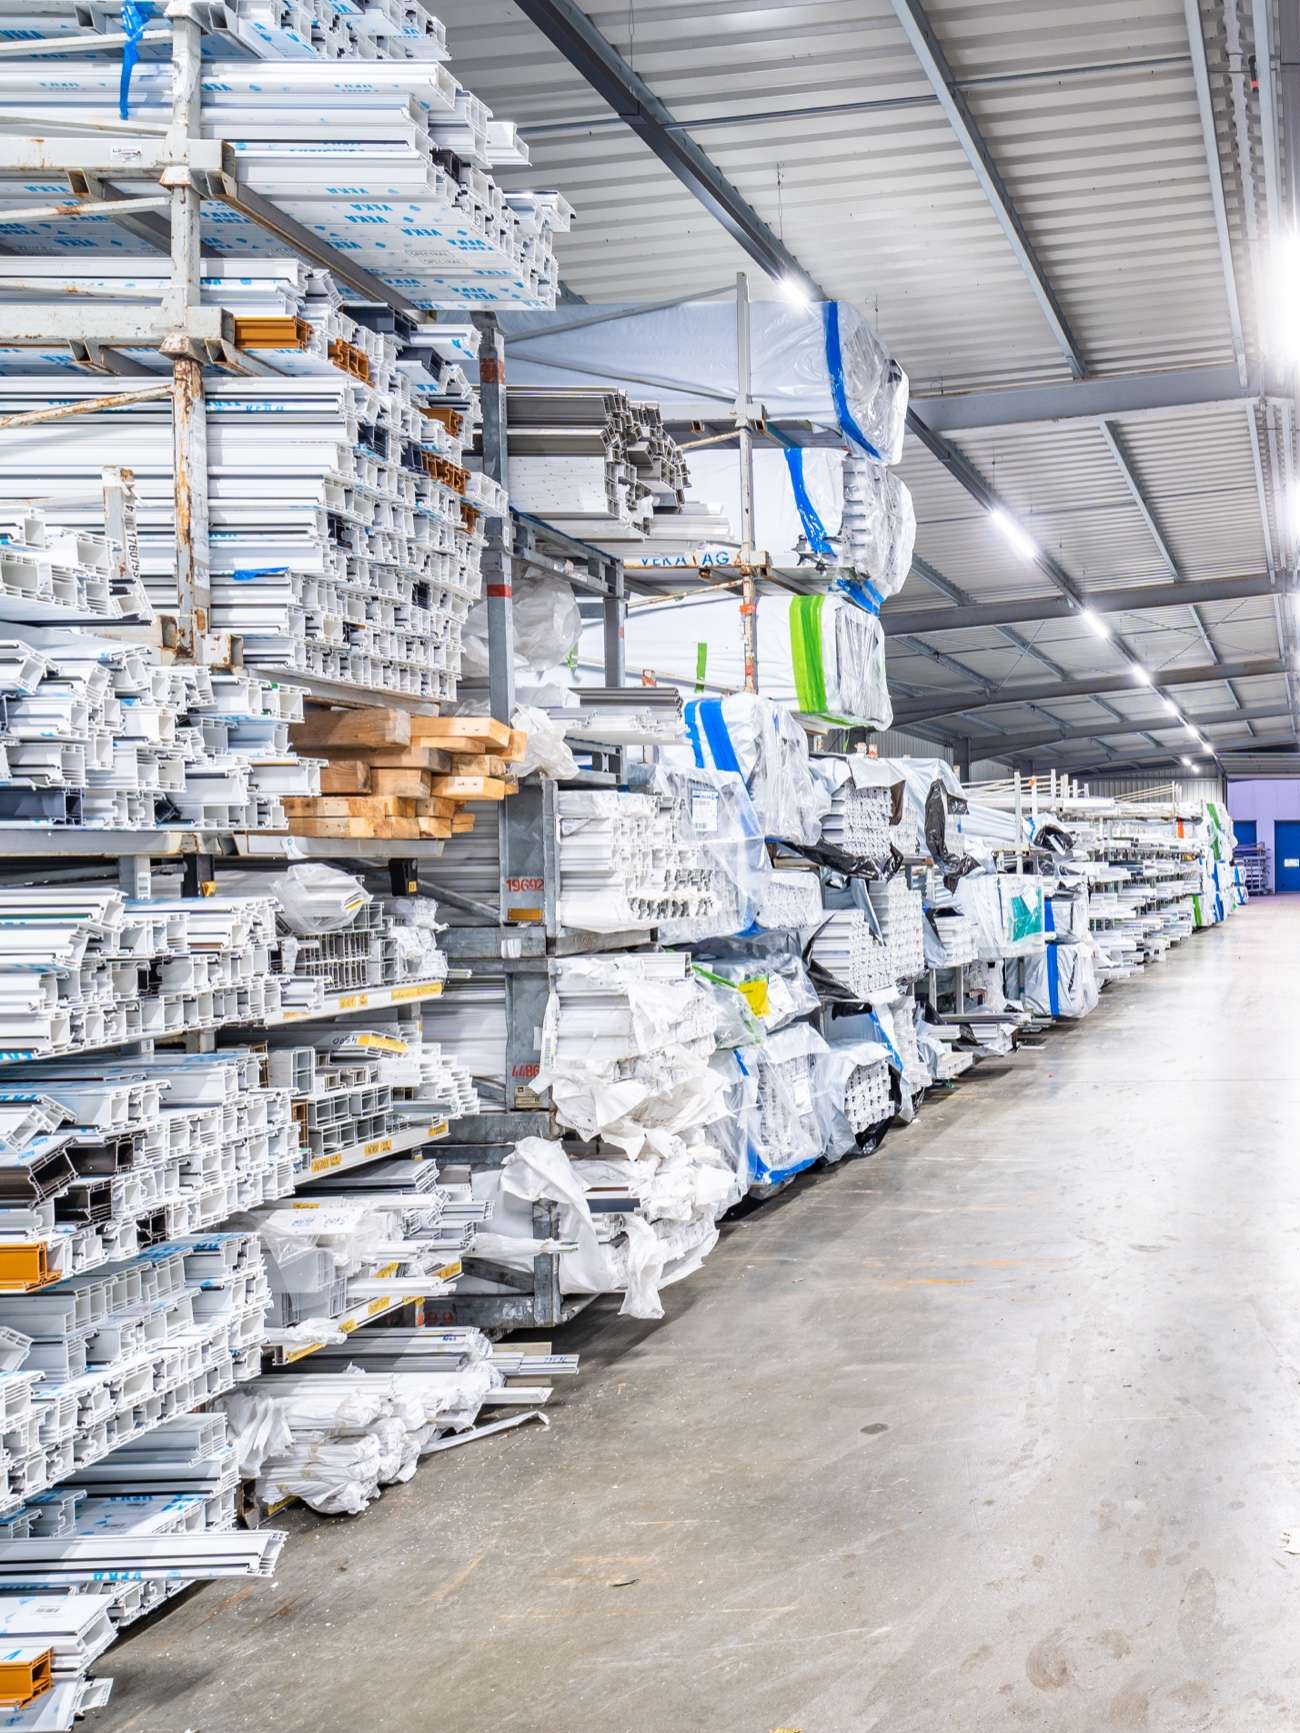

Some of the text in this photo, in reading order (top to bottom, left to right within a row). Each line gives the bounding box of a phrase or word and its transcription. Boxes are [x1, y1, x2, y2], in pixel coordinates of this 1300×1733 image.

[349, 203, 393, 211] VEKA
[344, 215, 390, 223] VEKA
[401, 228, 443, 237] VEKA
[701, 551, 730, 566] AG
